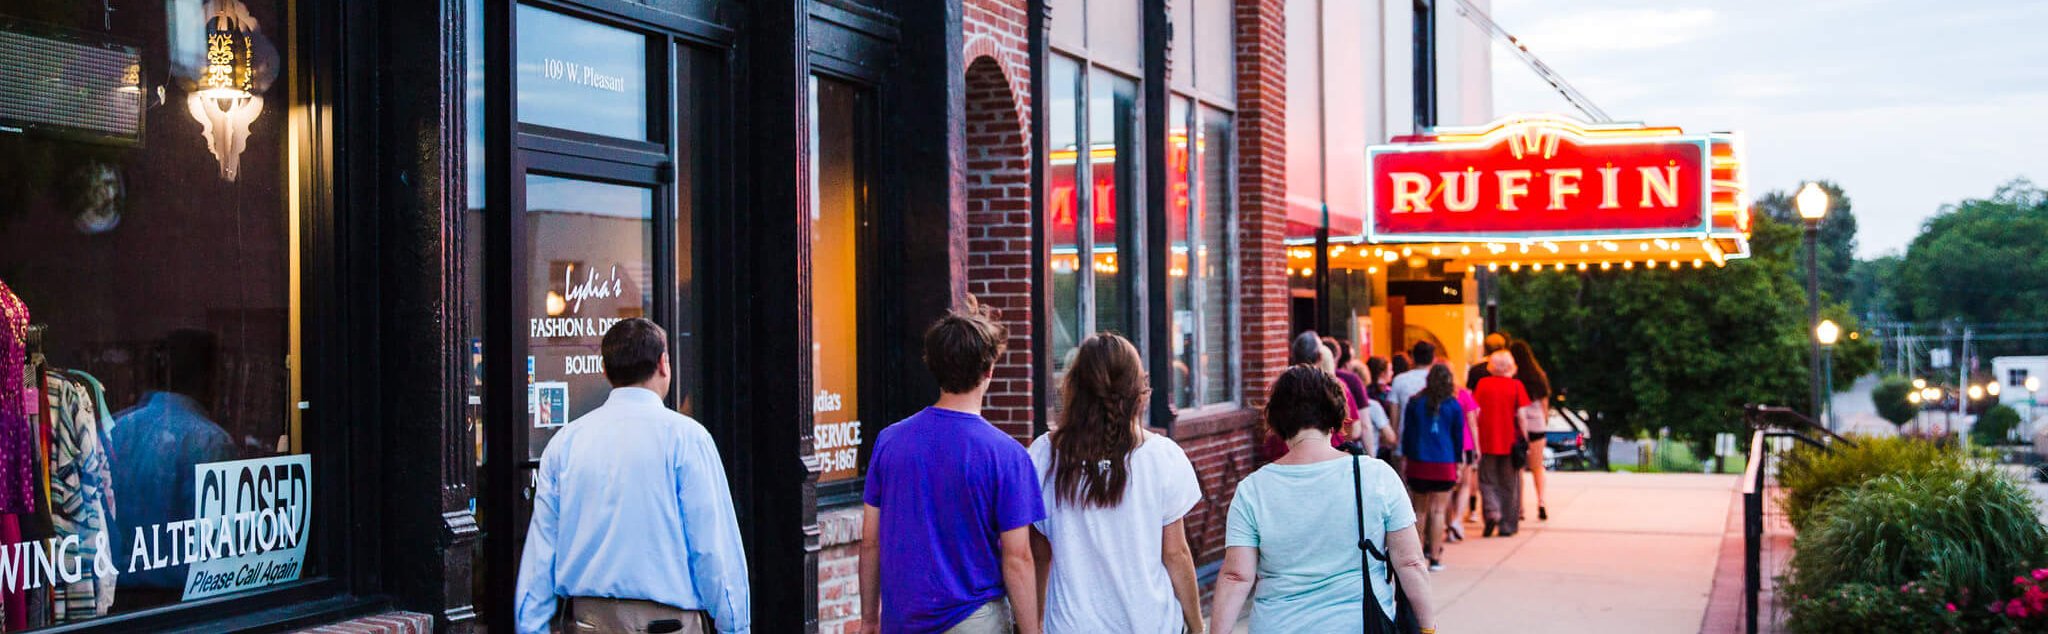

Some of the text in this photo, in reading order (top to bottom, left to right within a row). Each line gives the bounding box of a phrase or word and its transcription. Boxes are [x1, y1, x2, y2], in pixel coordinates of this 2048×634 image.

[544, 58, 624, 93] 109 W. Pleasant
[1388, 163, 1681, 214] RUFFIN
[565, 264, 622, 314] Lydia's
[530, 317, 583, 337] FASHION
[586, 317, 597, 336] &
[813, 421, 862, 451] SERVICE
[815, 447, 858, 473] 75-1867
[200, 463, 307, 562] CLOSED
[94, 531, 119, 578] &
[128, 505, 296, 574] ALTERATION
[189, 557, 299, 595] Please Call Again
